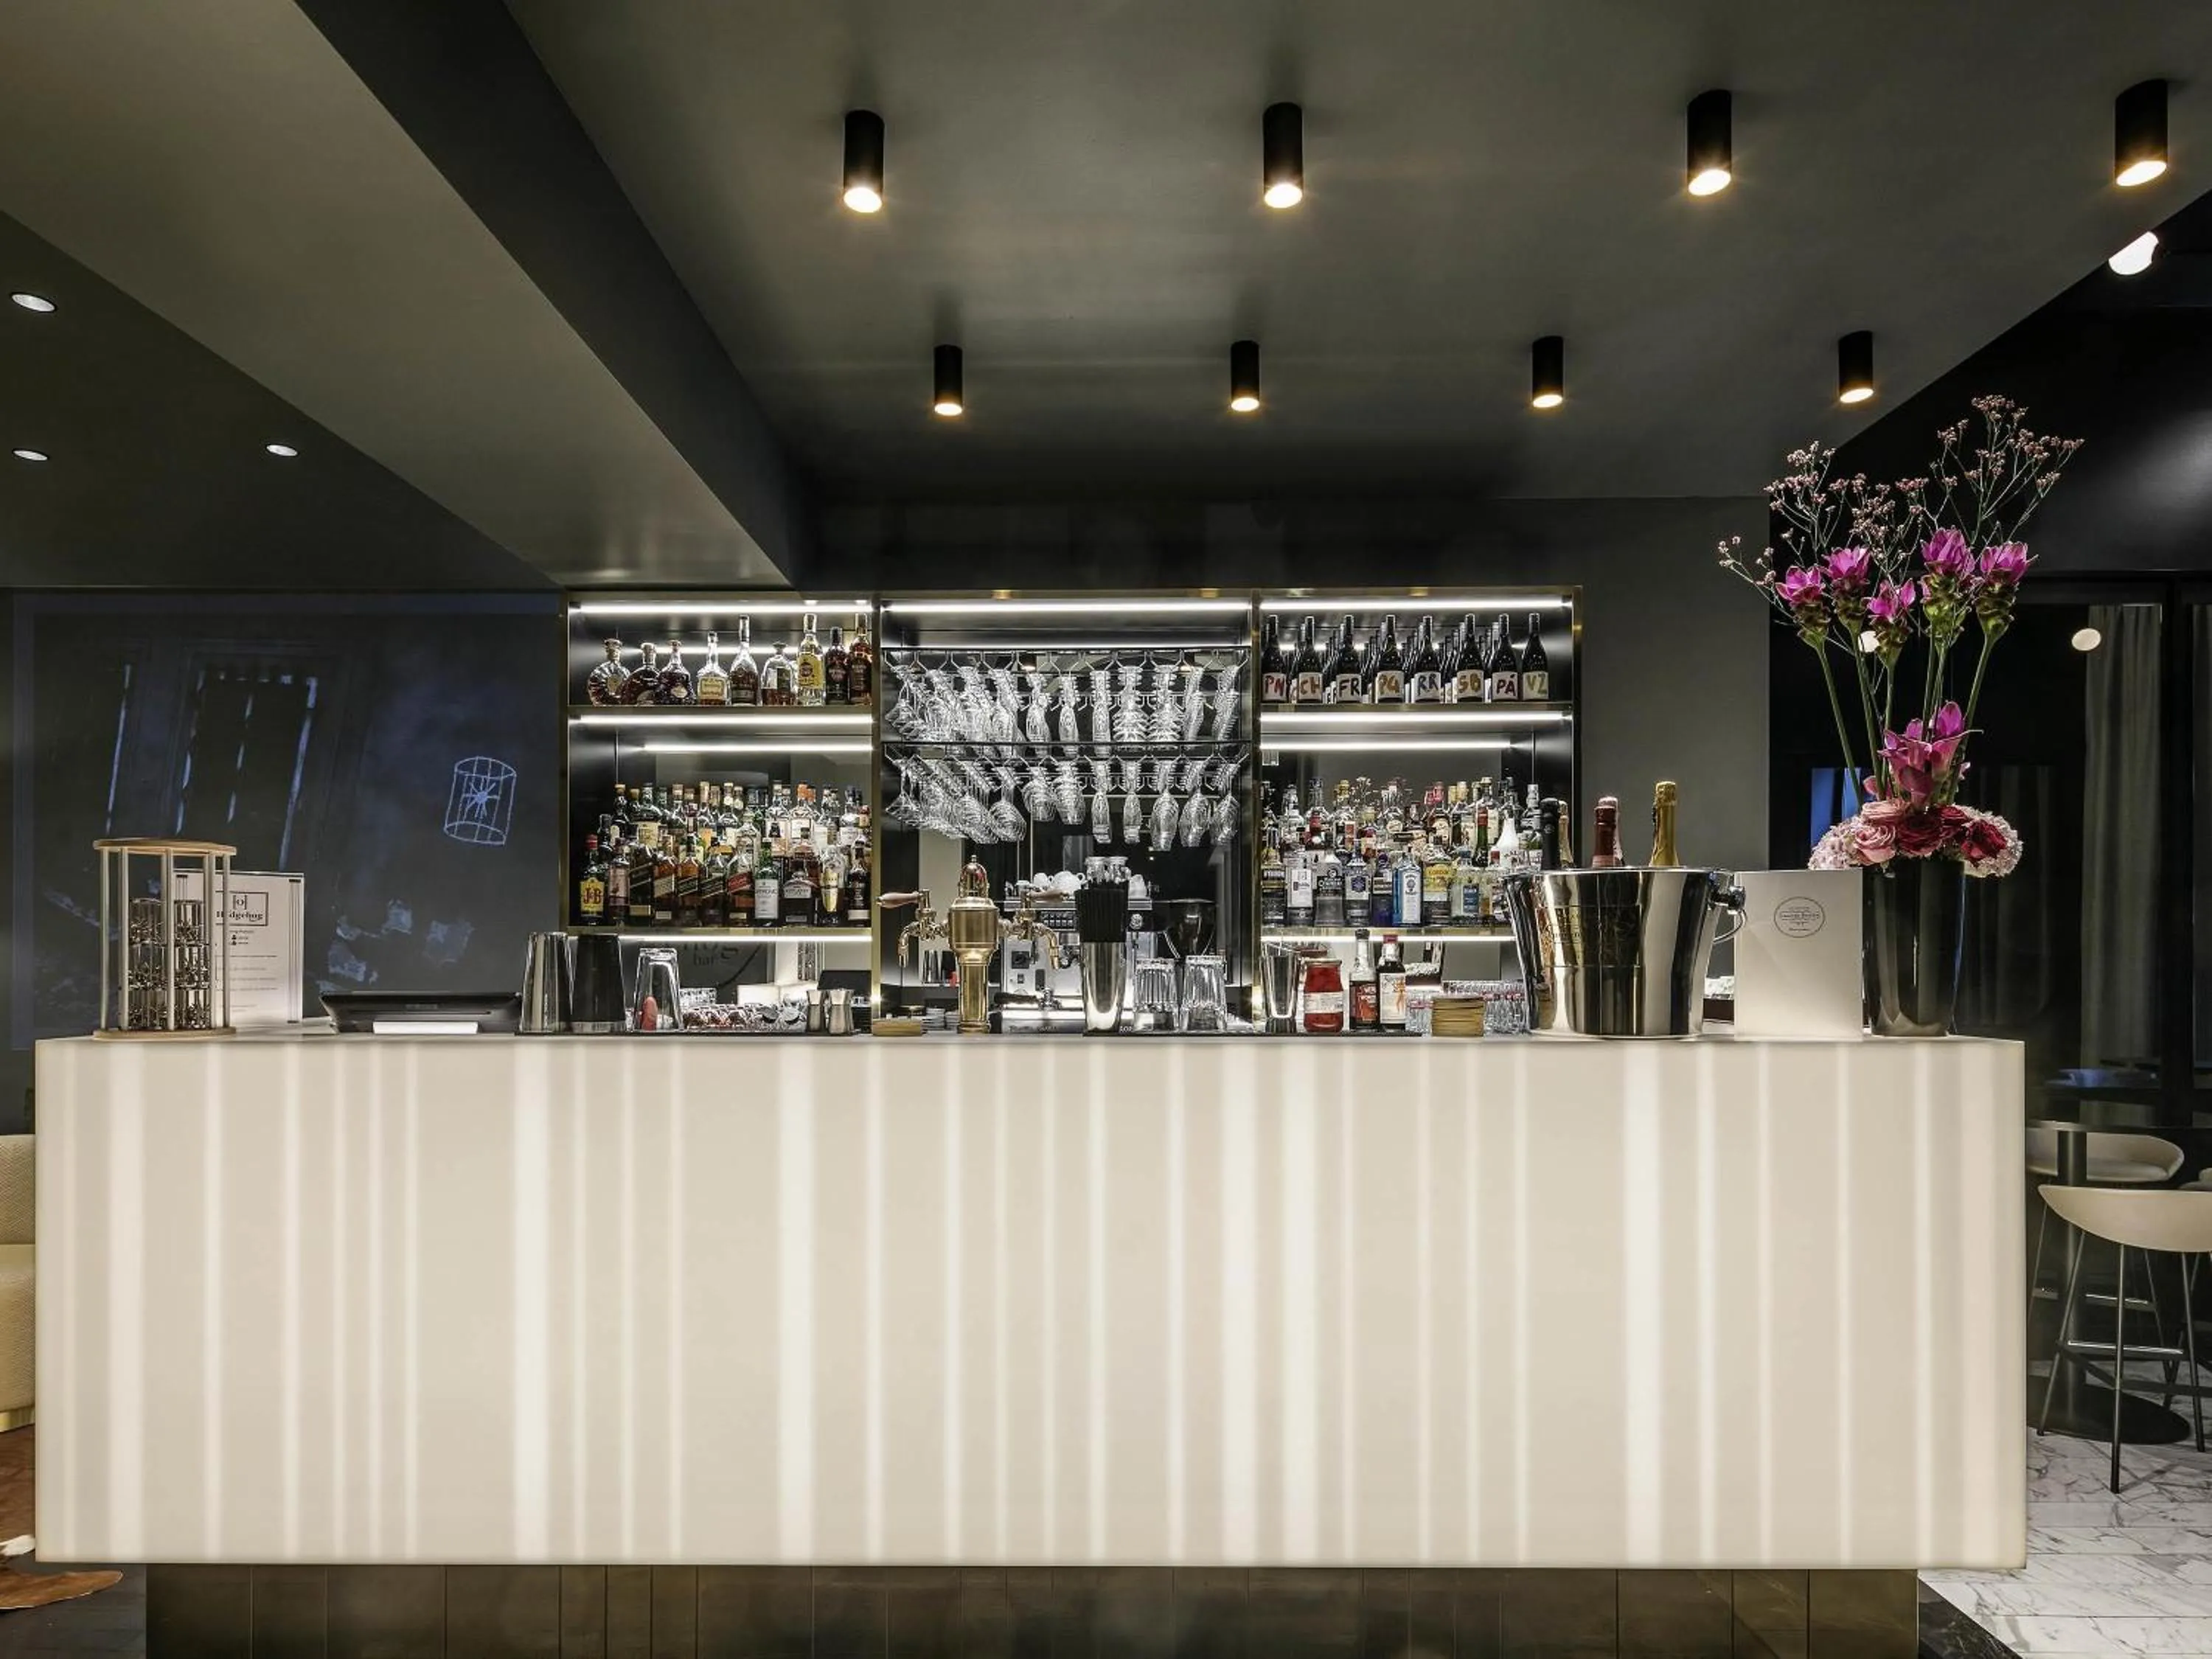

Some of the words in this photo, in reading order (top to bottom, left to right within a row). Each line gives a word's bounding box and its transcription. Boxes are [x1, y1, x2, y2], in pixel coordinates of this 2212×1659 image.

[1265, 675, 1284, 697] PN
[1300, 677, 1320, 695] CH
[1339, 678, 1360, 697] FR
[1417, 674, 1438, 696] RR
[216, 911, 263, 922] Hdgehog
